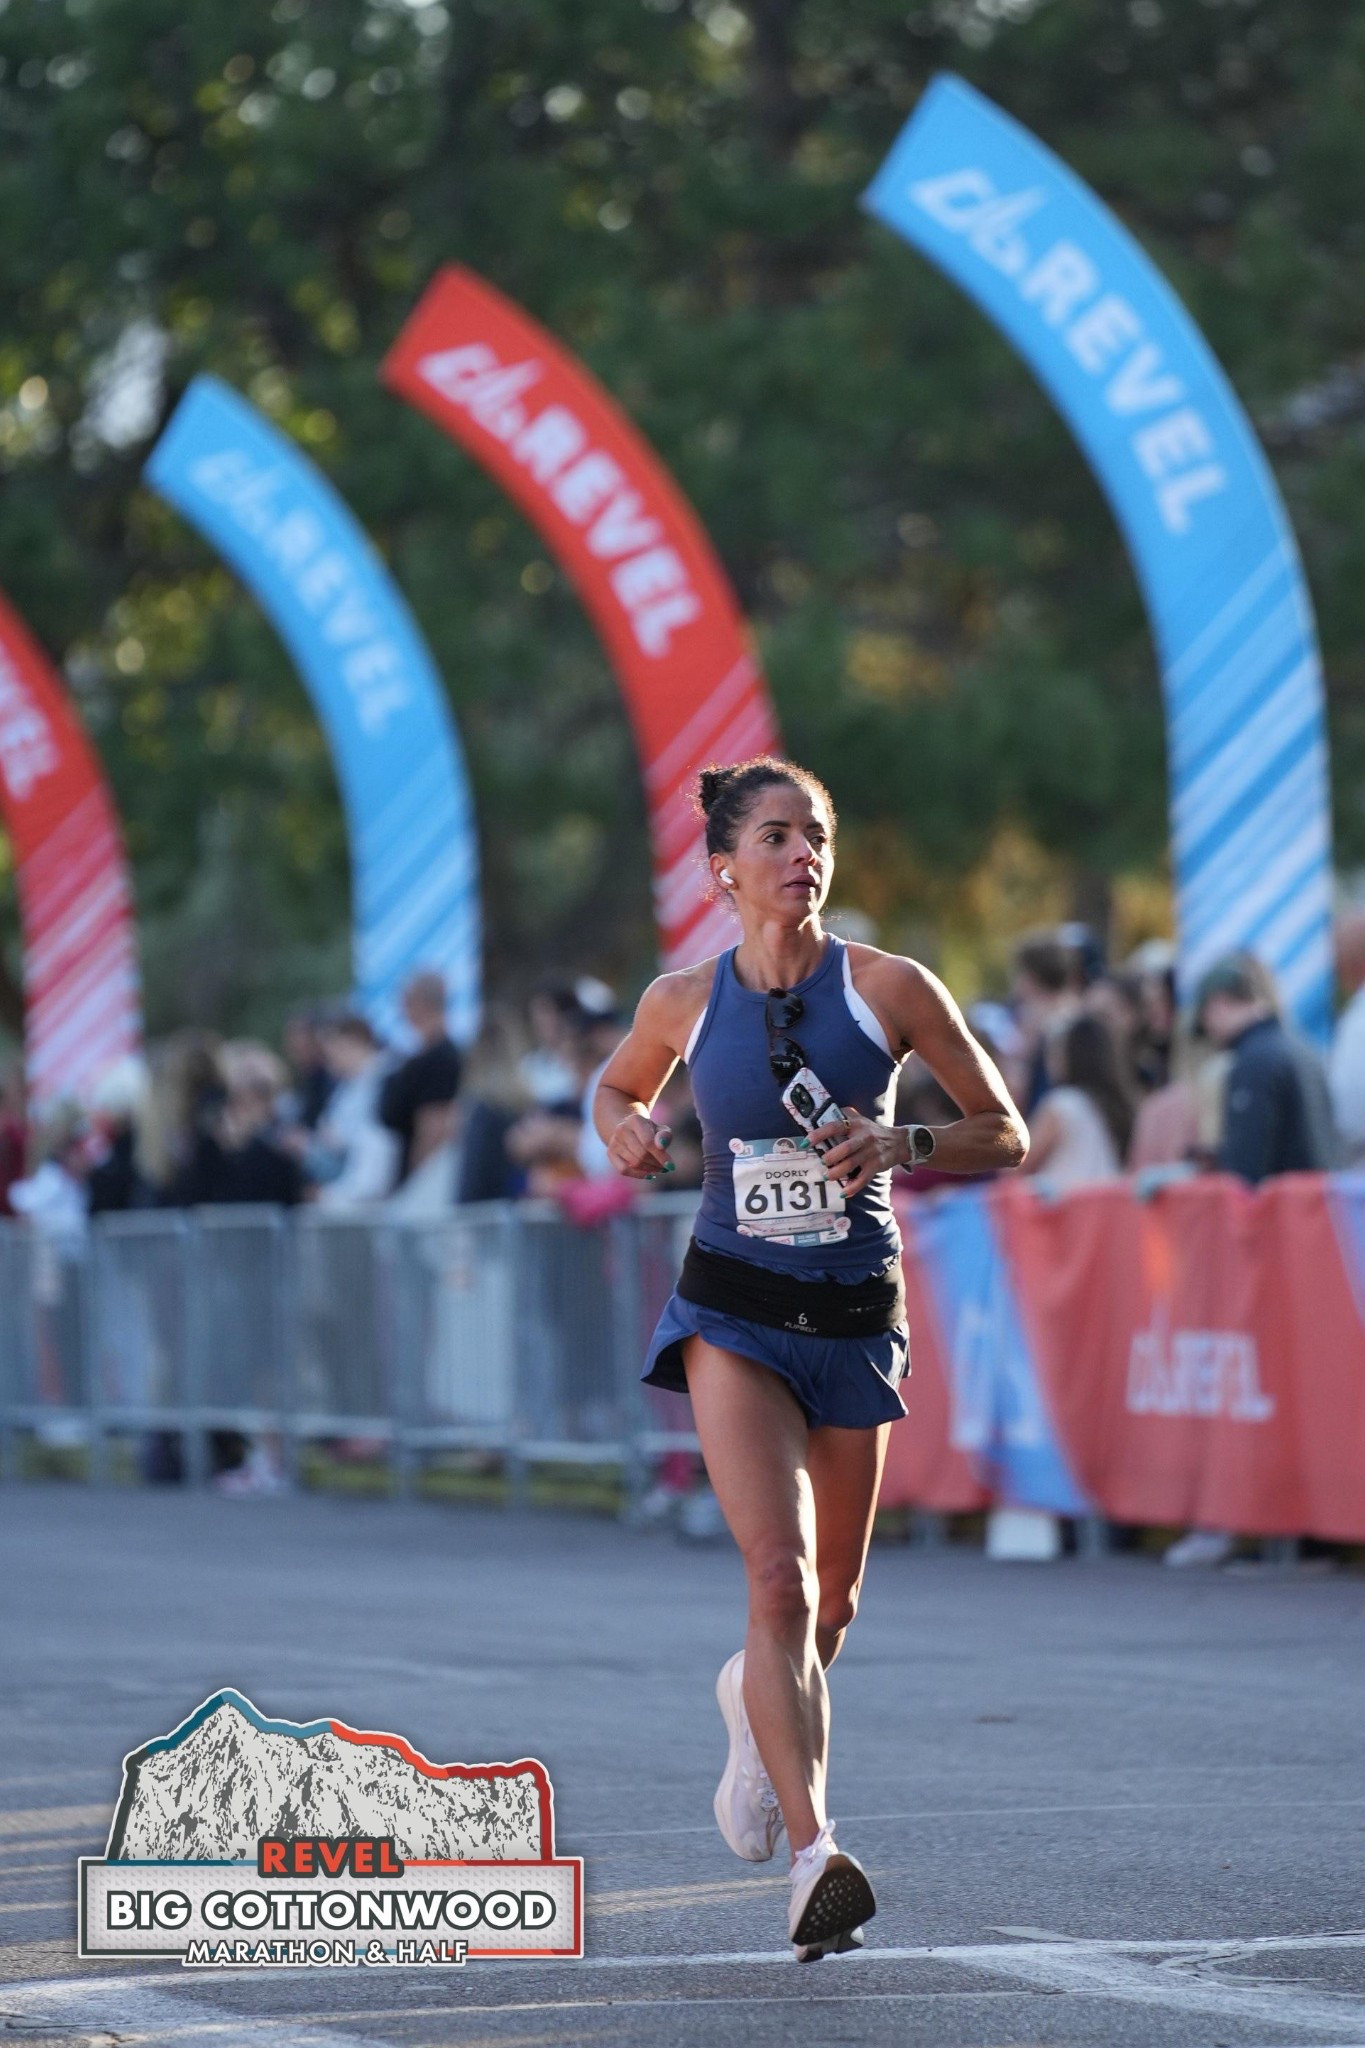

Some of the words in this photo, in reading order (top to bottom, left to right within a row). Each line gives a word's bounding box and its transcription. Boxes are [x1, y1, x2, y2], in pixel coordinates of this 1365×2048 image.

[1019, 239, 1227, 535] REVEL
[509, 405, 700, 659] REVEL
[744, 1180, 828, 1215] 6131
[765, 1169, 809, 1180] DOORLY
